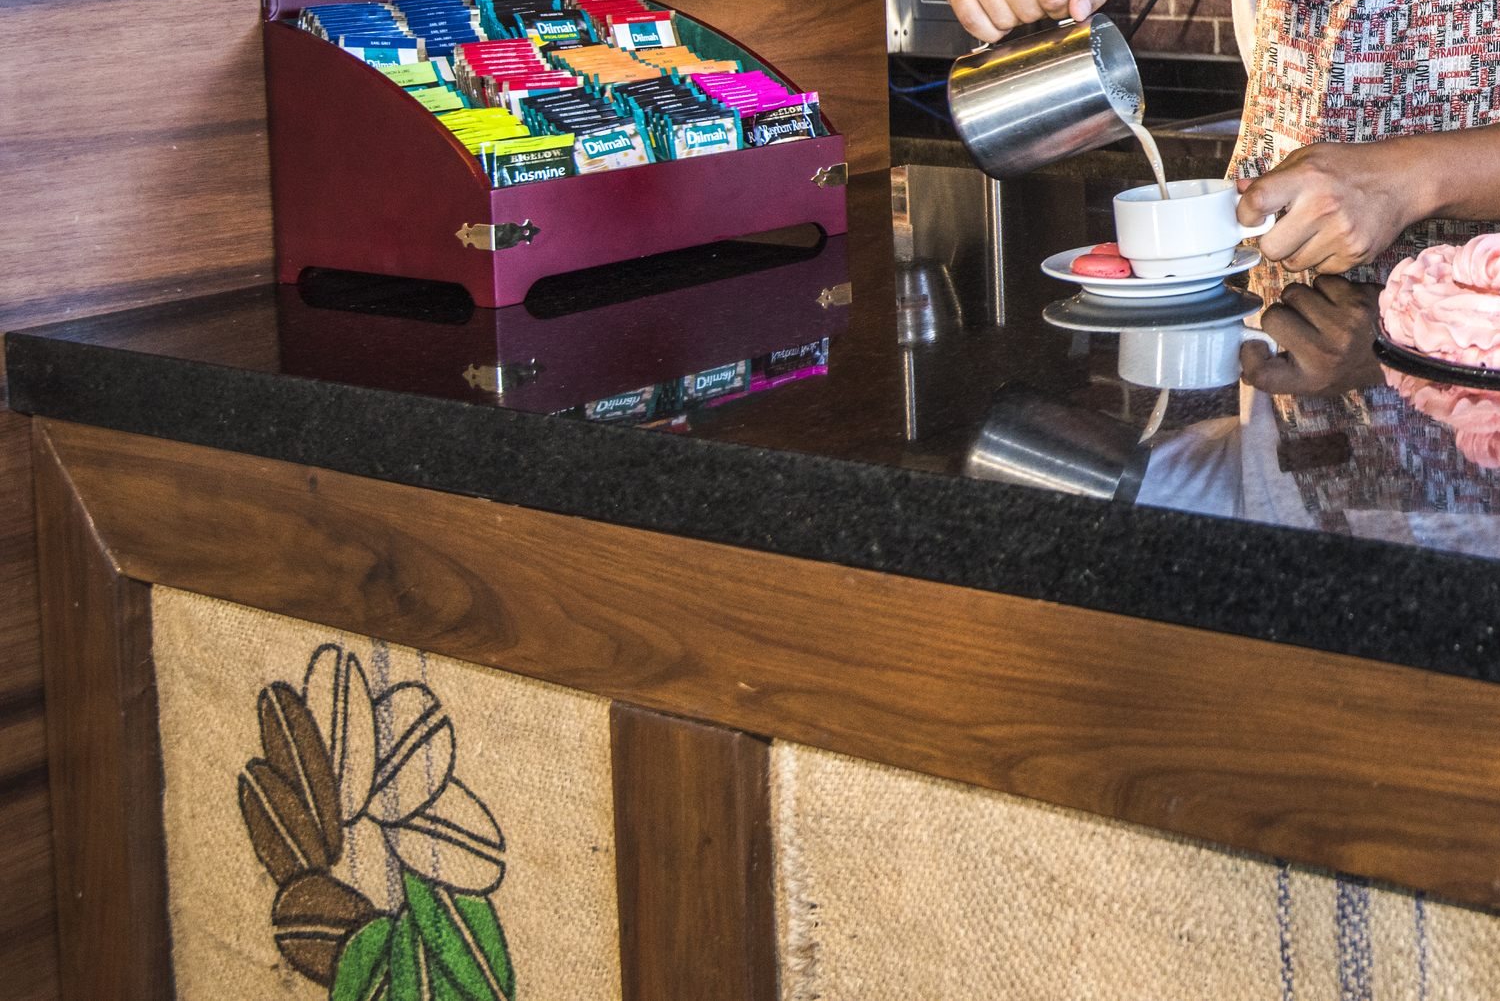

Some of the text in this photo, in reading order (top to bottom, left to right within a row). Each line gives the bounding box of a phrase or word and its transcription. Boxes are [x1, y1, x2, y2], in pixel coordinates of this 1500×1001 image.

[1417, 13, 1446, 27] COFFEE
[537, 21, 577, 34] Dilmah
[632, 33, 659, 43] Dilmah
[1452, 36, 1469, 45] DARK
[1469, 35, 1497, 45] CLASSIC
[1368, 43, 1384, 52] DARK
[1384, 42, 1407, 52] CLASSIC
[1436, 44, 1486, 60] TRADITIONAL
[1352, 52, 1399, 63] TRADITIONAL
[1400, 50, 1415, 61] CUP
[1305, 53, 1315, 87] QUALITY
[1330, 61, 1345, 87] LOVE
[1415, 59, 1429, 85] LOVE
[1438, 70, 1470, 79] MACCHIATO
[1470, 53, 1479, 87] QUALITY
[1383, 61, 1392, 95] QUALITY
[1413, 104, 1444, 117] COFFEE
[686, 127, 727, 144] Dilmah
[1264, 128, 1274, 155] LOVE
[584, 135, 631, 154] Dilmah
[511, 150, 563, 163] BIGELOW
[514, 166, 565, 183] Jasmine
